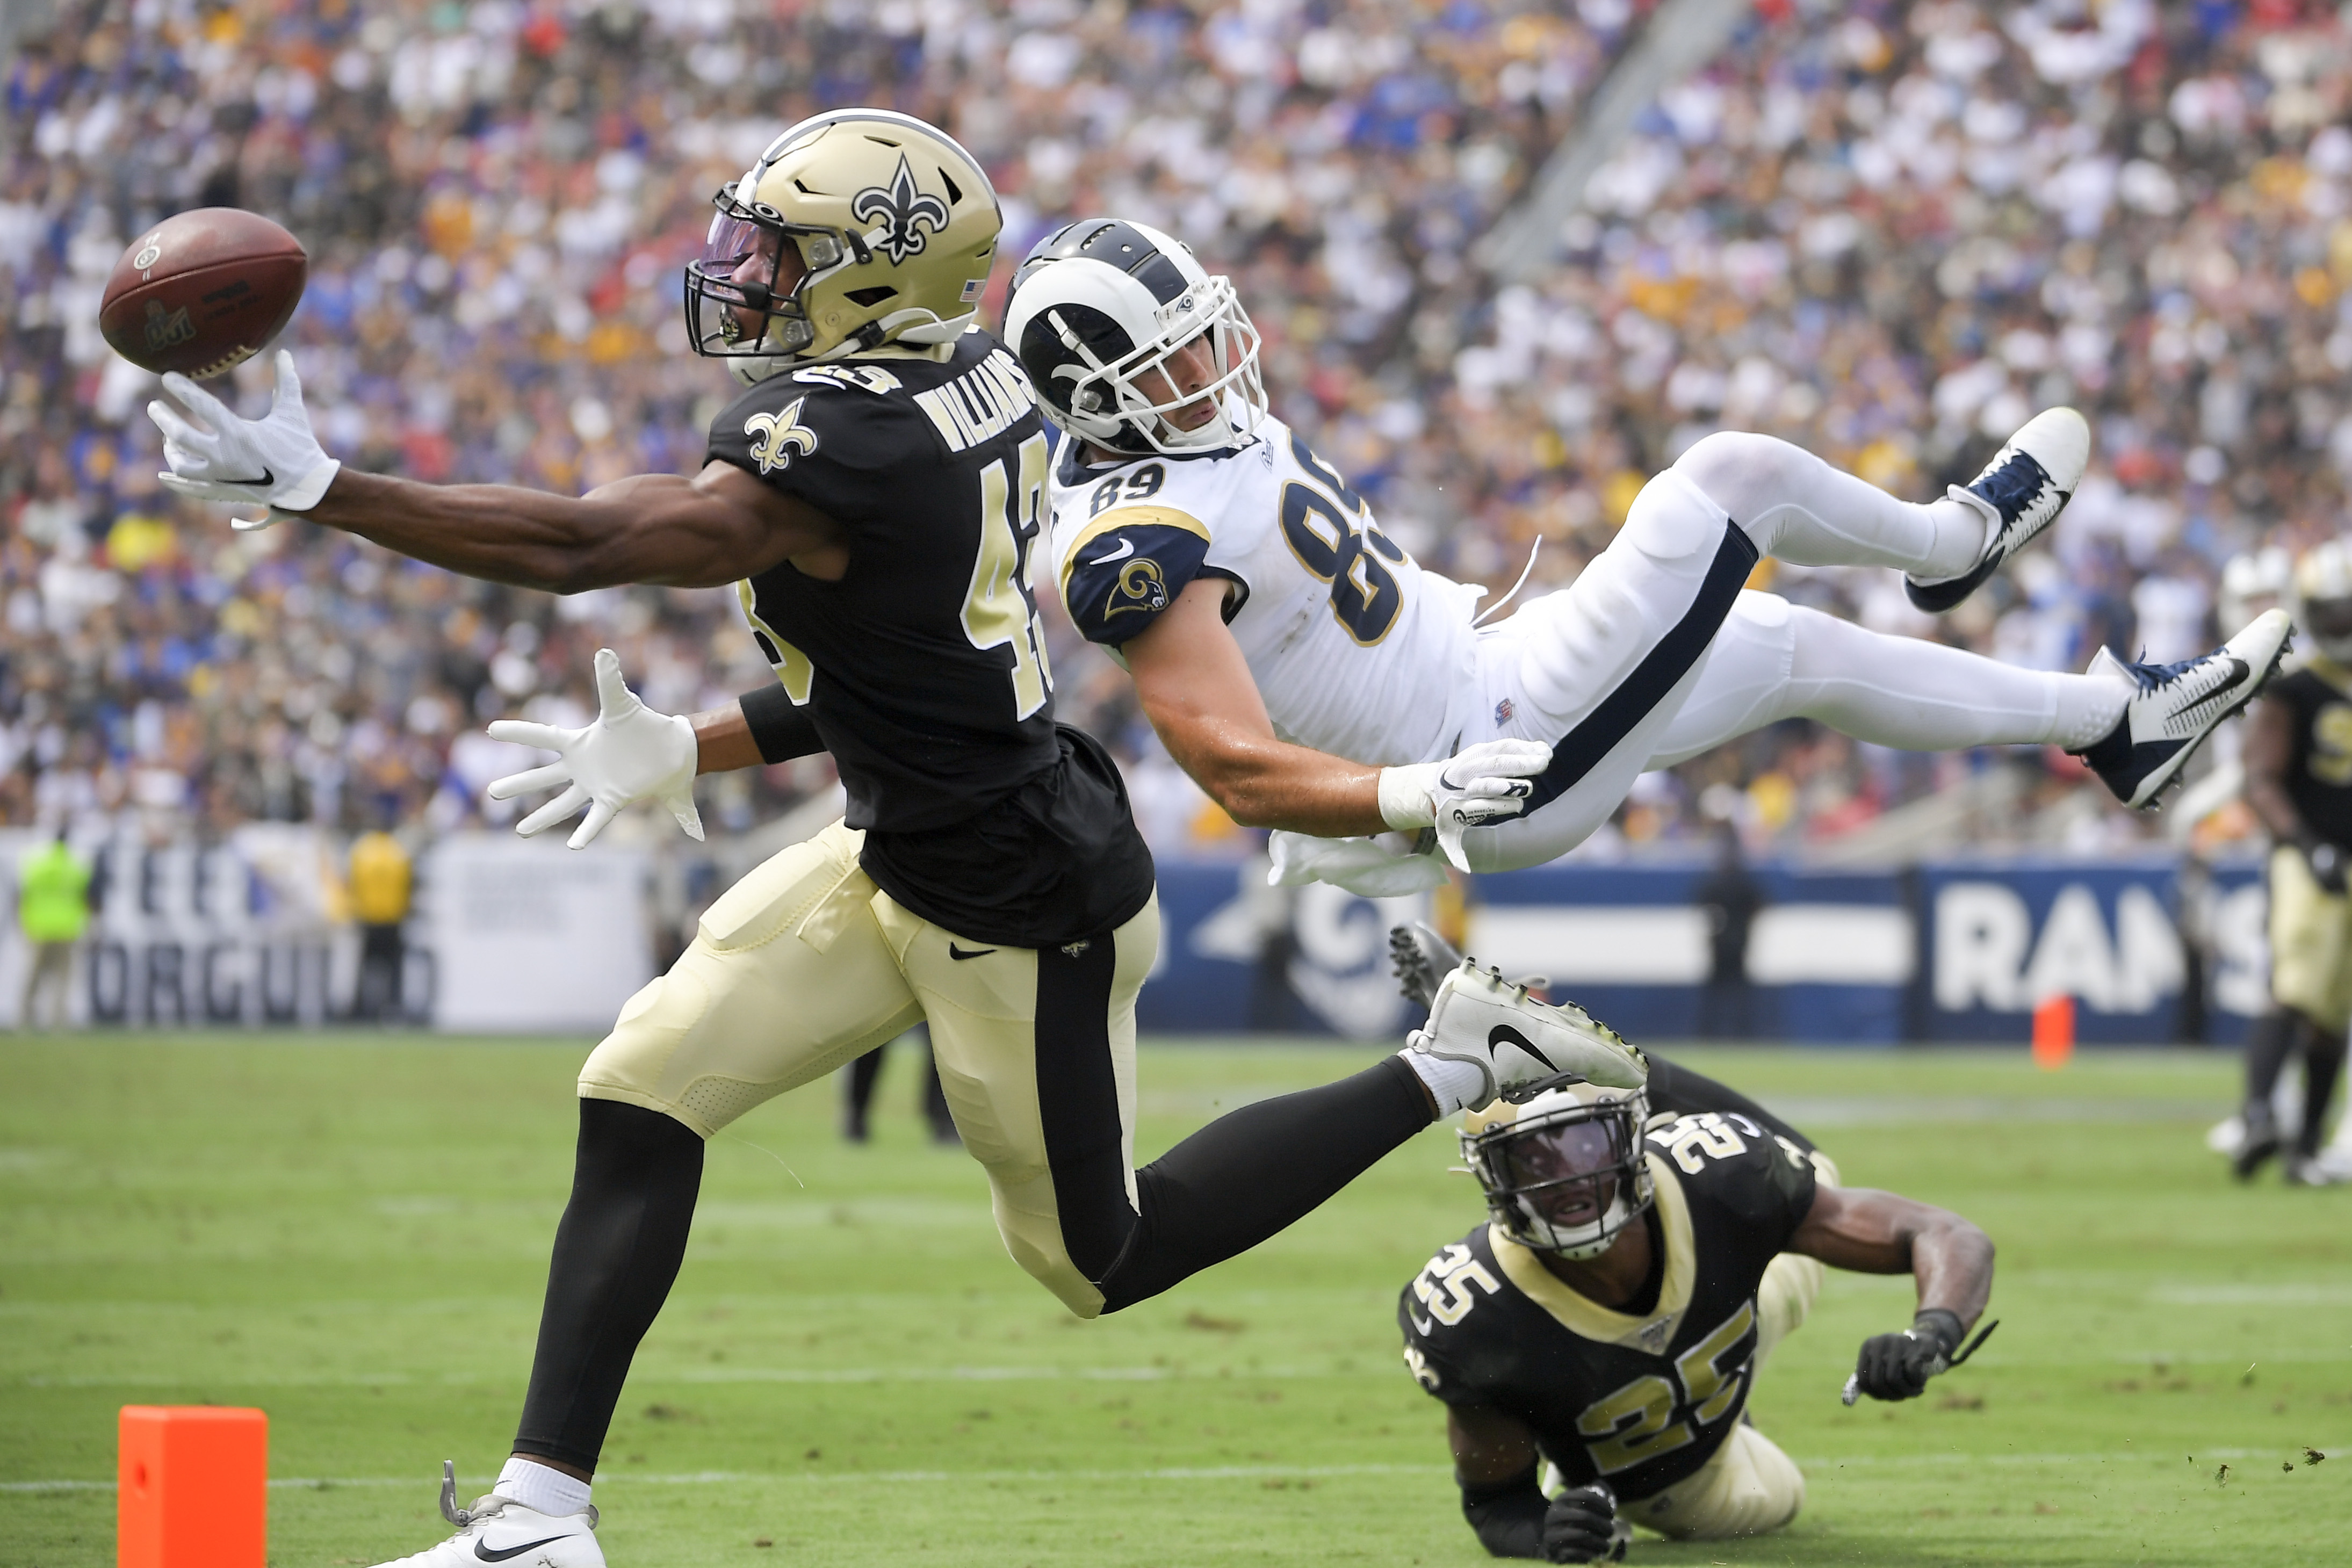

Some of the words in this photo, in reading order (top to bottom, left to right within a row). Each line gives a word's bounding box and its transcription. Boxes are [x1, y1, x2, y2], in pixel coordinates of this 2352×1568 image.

[912, 348, 1036, 453] WILLIAMS
[1089, 463, 1166, 518] 89
[1413, 1243, 1500, 1327] 25
[1576, 1298, 1757, 1476] 25
